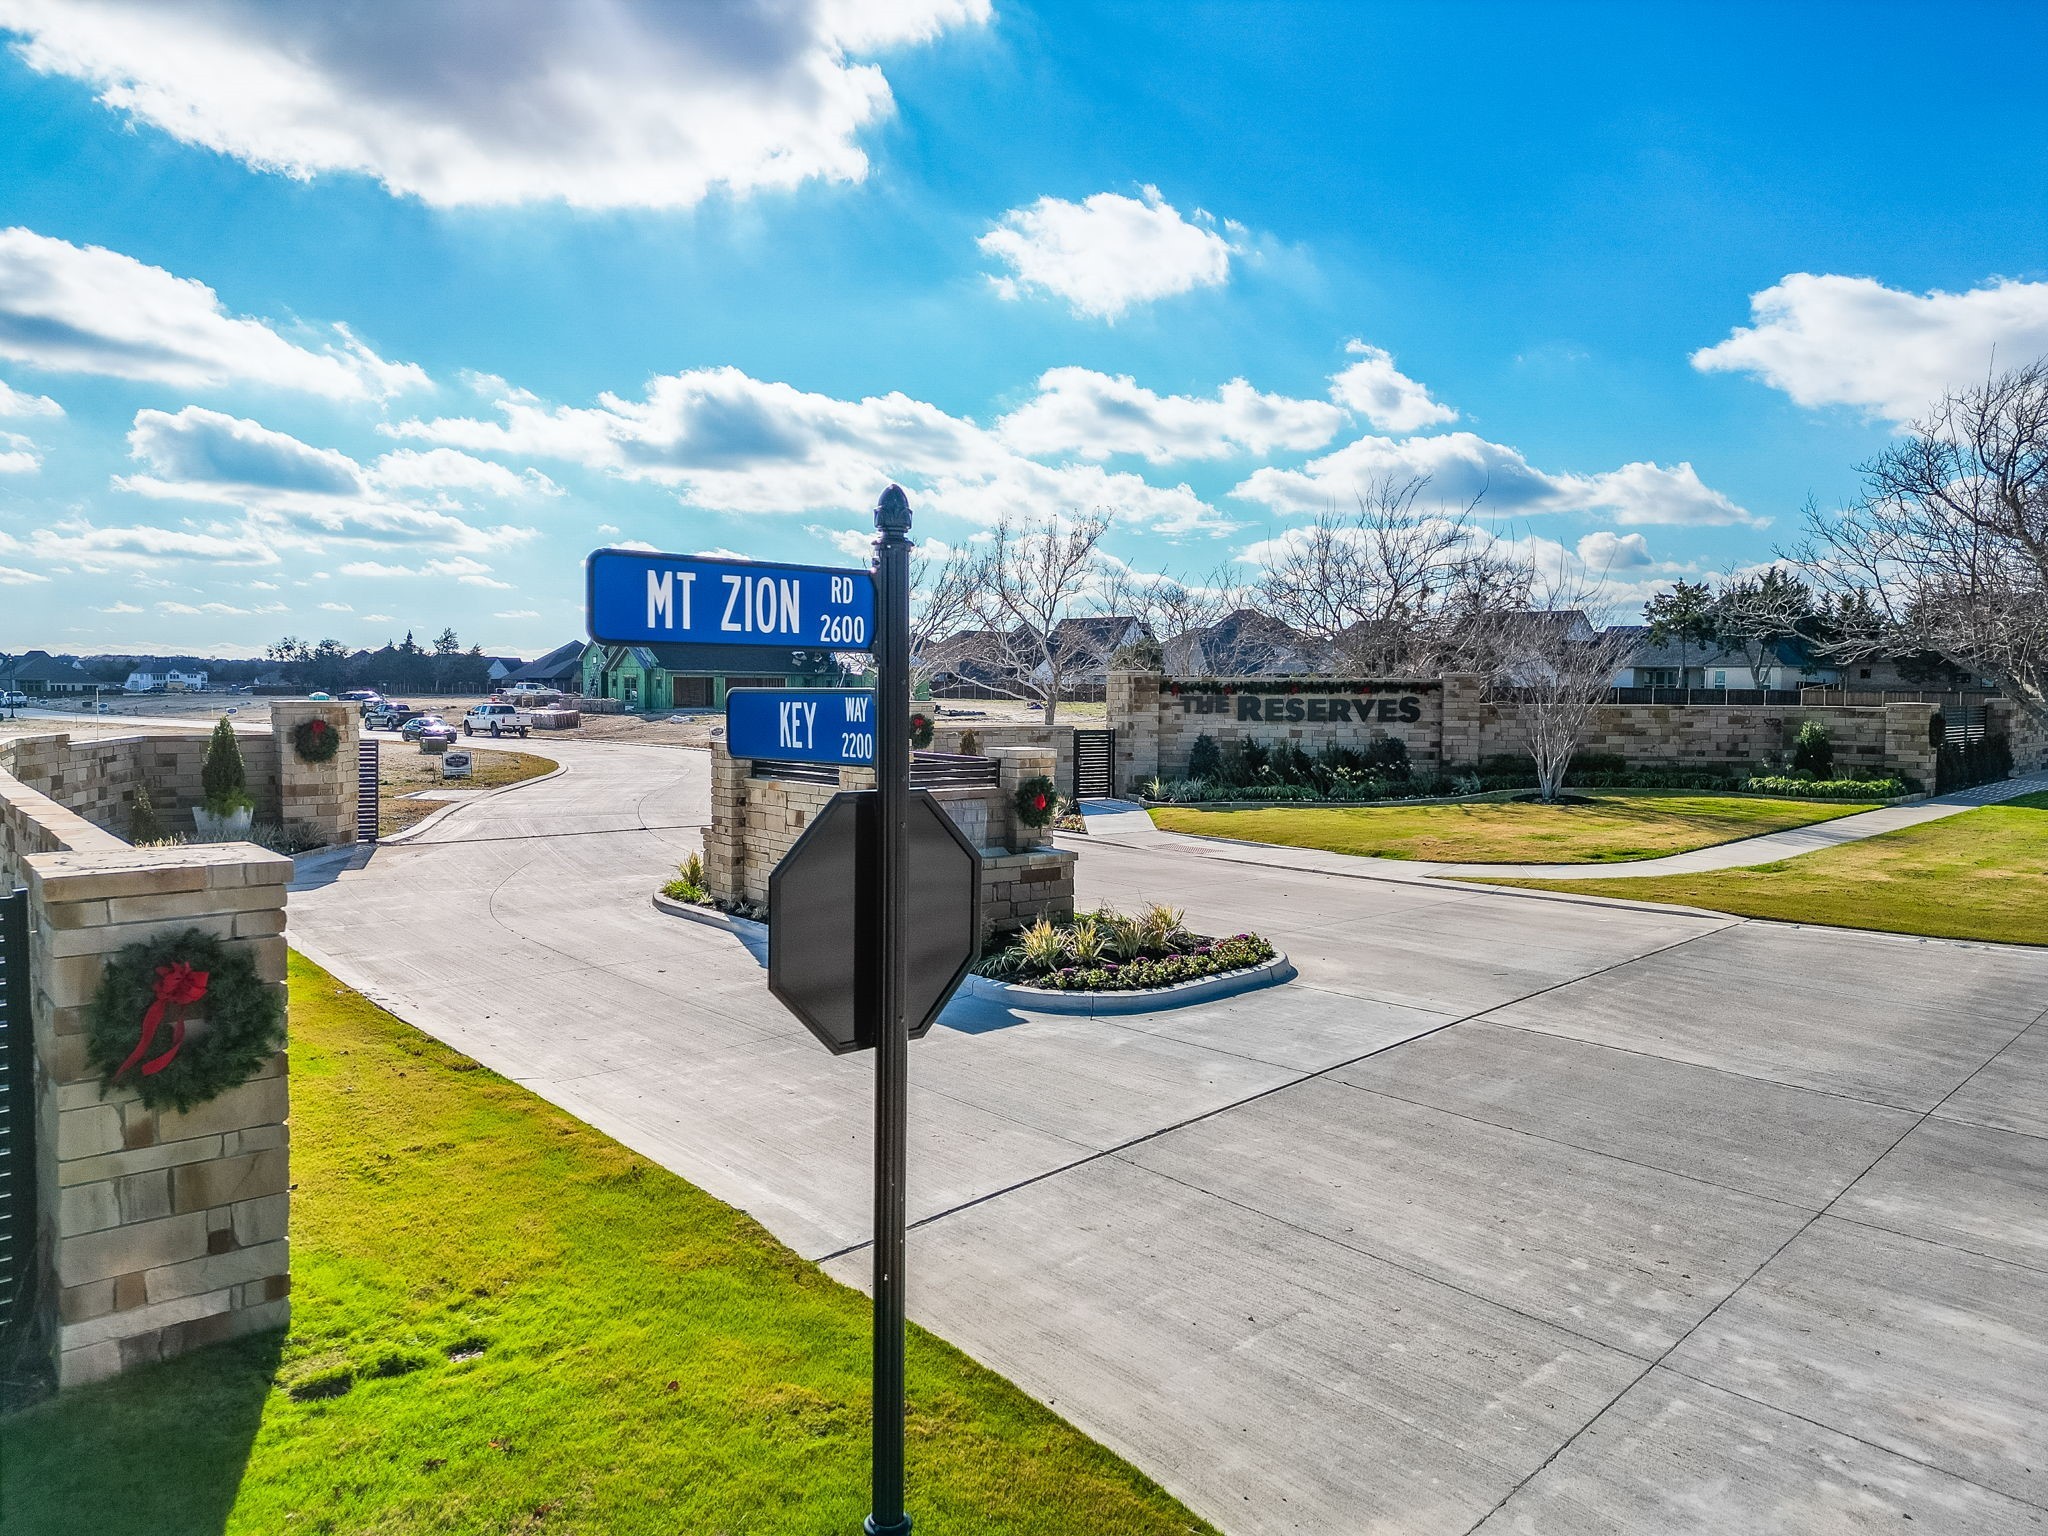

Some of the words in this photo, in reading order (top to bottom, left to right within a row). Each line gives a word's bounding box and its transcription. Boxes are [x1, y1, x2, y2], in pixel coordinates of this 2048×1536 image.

[647, 570, 696, 629] MT
[720, 574, 799, 633] ZION
[831, 576, 853, 604] RD
[820, 615, 864, 644] 2600
[845, 697, 868, 723] WAY
[1179, 695, 1230, 714] THE
[1237, 696, 1420, 723] RESERVES
[779, 702, 817, 749] KEY
[842, 733, 872, 759] 2200
